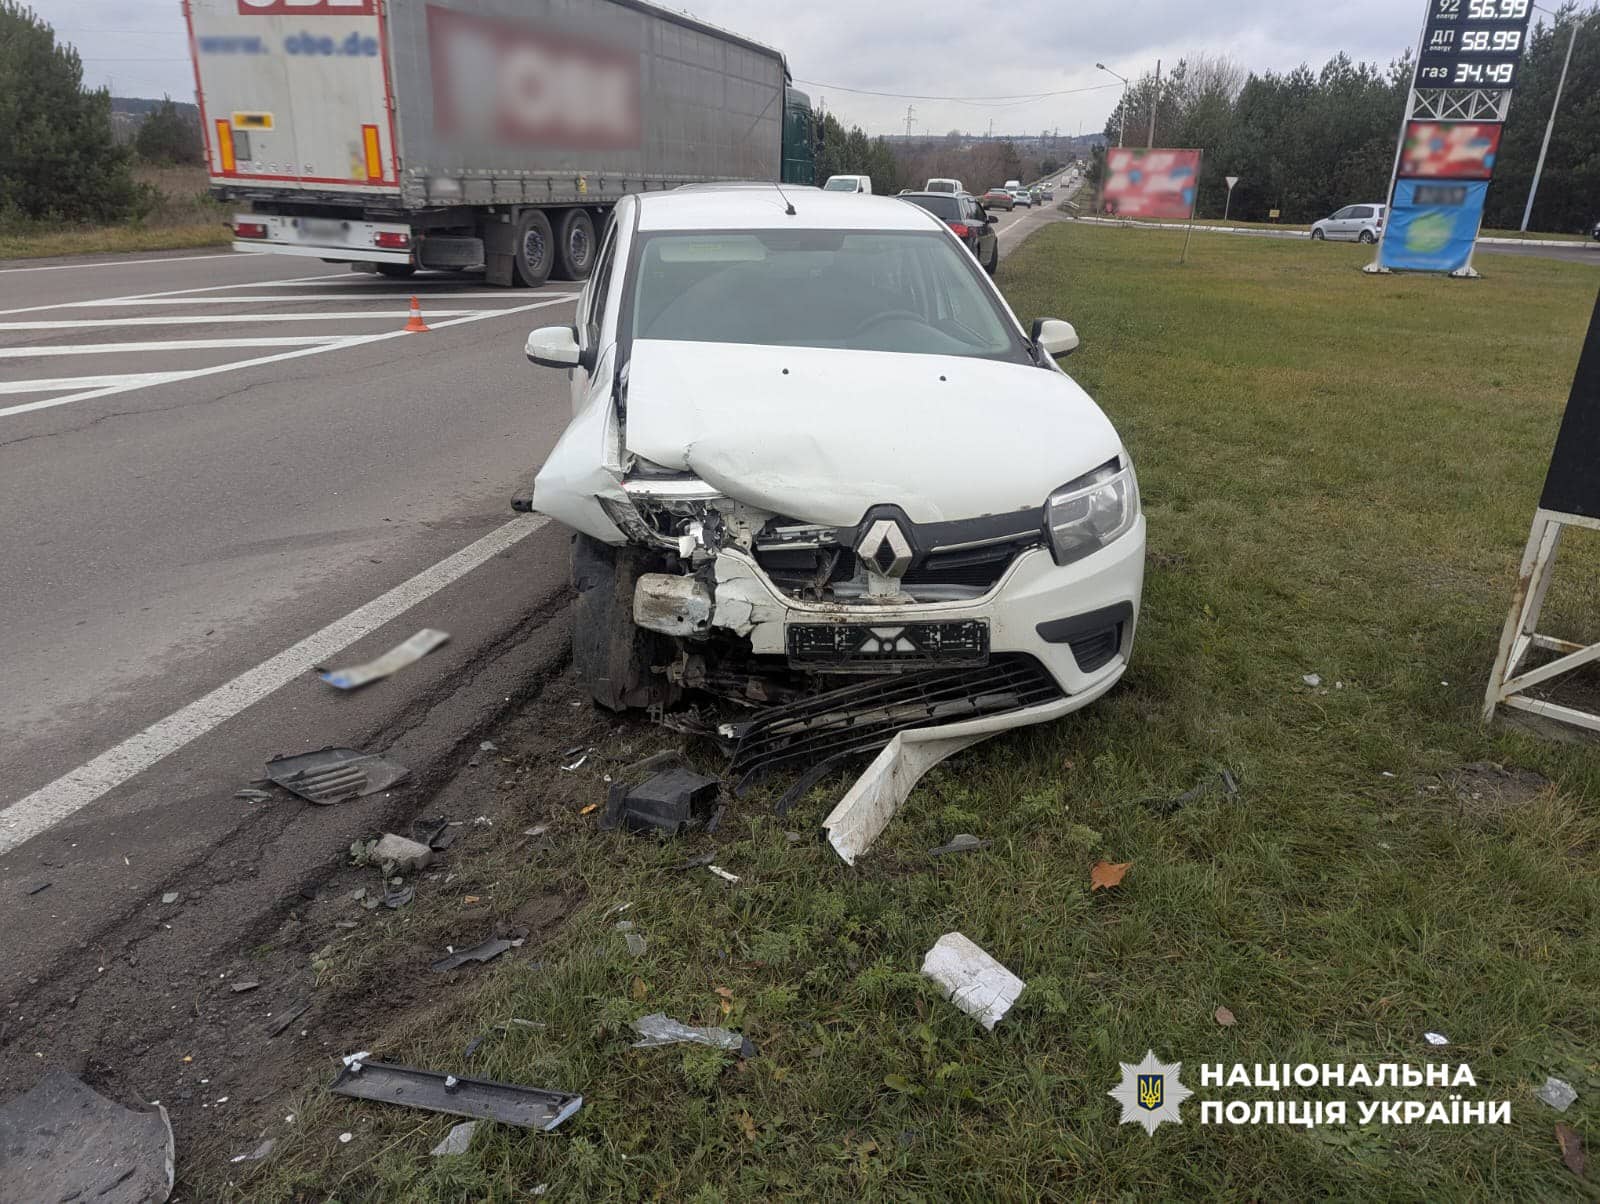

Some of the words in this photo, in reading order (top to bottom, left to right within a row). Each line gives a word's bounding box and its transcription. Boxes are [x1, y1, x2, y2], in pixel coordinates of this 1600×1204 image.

[1439, 0, 1460, 12] 92
[1468, 0, 1528, 19] 56.99
[1430, 30, 1455, 44] ДП
[1461, 31, 1521, 51] 58.99
[1422, 67, 1448, 78] газ
[1454, 64, 1513, 83] 34.49
